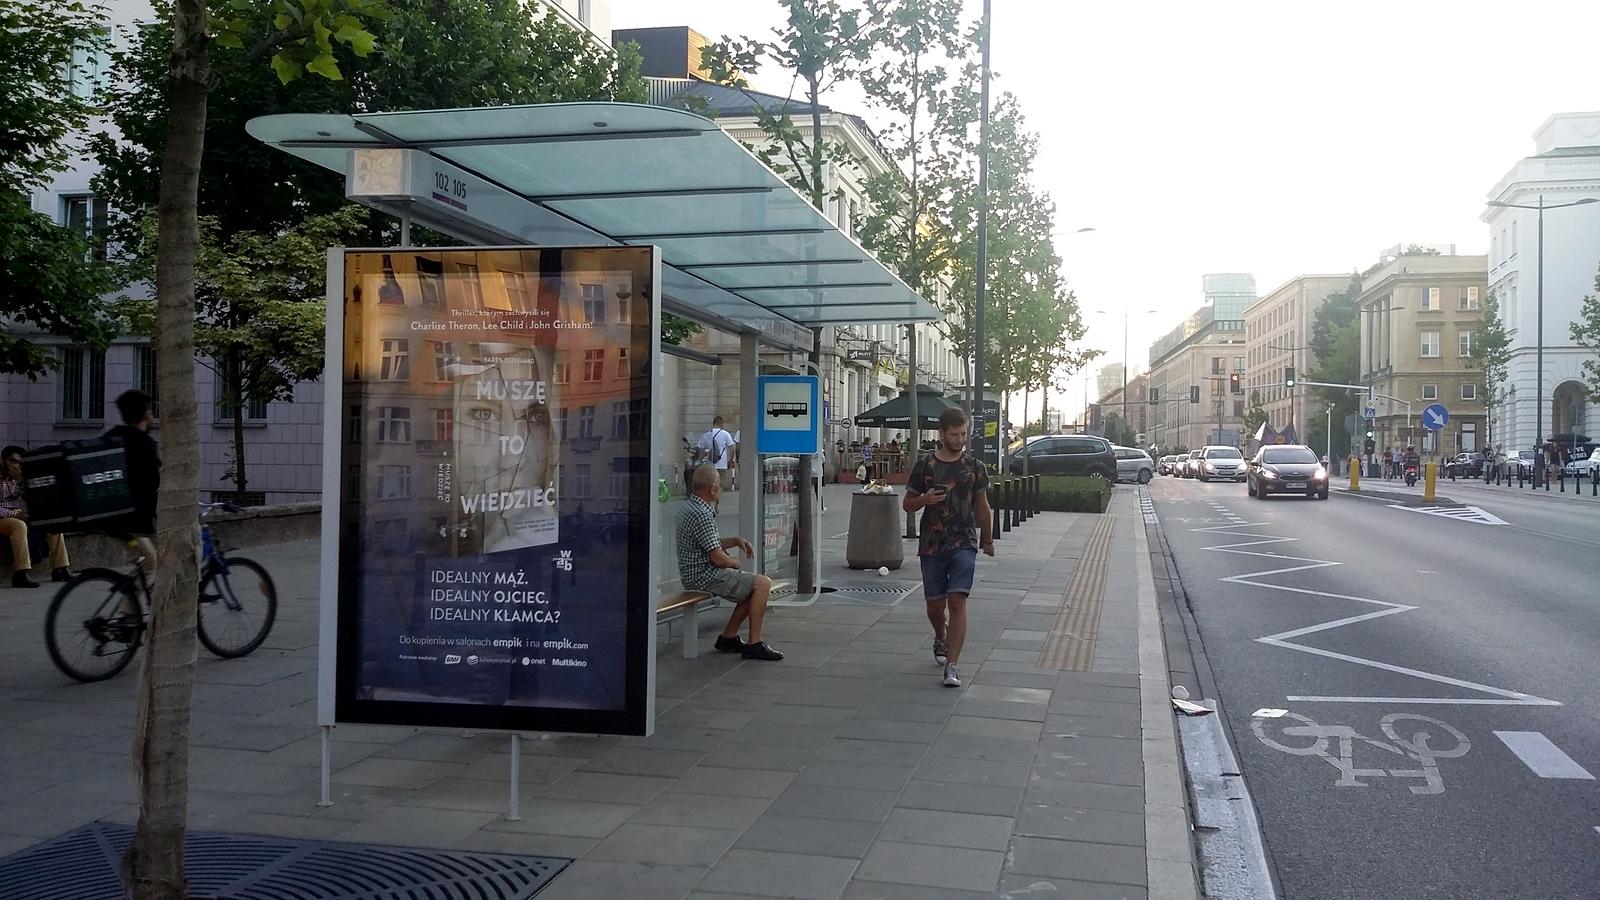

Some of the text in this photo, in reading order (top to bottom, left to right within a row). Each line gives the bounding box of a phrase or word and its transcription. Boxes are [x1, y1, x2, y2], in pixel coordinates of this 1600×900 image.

[435, 172, 466, 198] 102 105
[410, 321, 446, 331] Charlize
[448, 321, 481, 331] Theron,
[482, 321, 498, 330] Lee
[500, 320, 524, 330] Child
[529, 320, 551, 330] John
[553, 319, 594, 330] Grisham!
[476, 380, 547, 404] MUSZĘ
[499, 435, 524, 455] TO
[82, 469, 124, 484] UBER
[460, 481, 555, 514] WIEDZIEĆ
[431, 568, 529, 588] IDEALNY MĄŻ.
[431, 589, 549, 605] IDEALNY OJCIEC.
[430, 607, 561, 624] IDEALNY KŁAMCA?
[399, 635, 412, 644] Do
[412, 635, 446, 646] kupienia
[455, 637, 491, 647] salonach
[492, 638, 522, 649] empik
[530, 640, 540, 648] na
[543, 638, 589, 650] empik.com
[551, 658, 588, 668] Multikino
